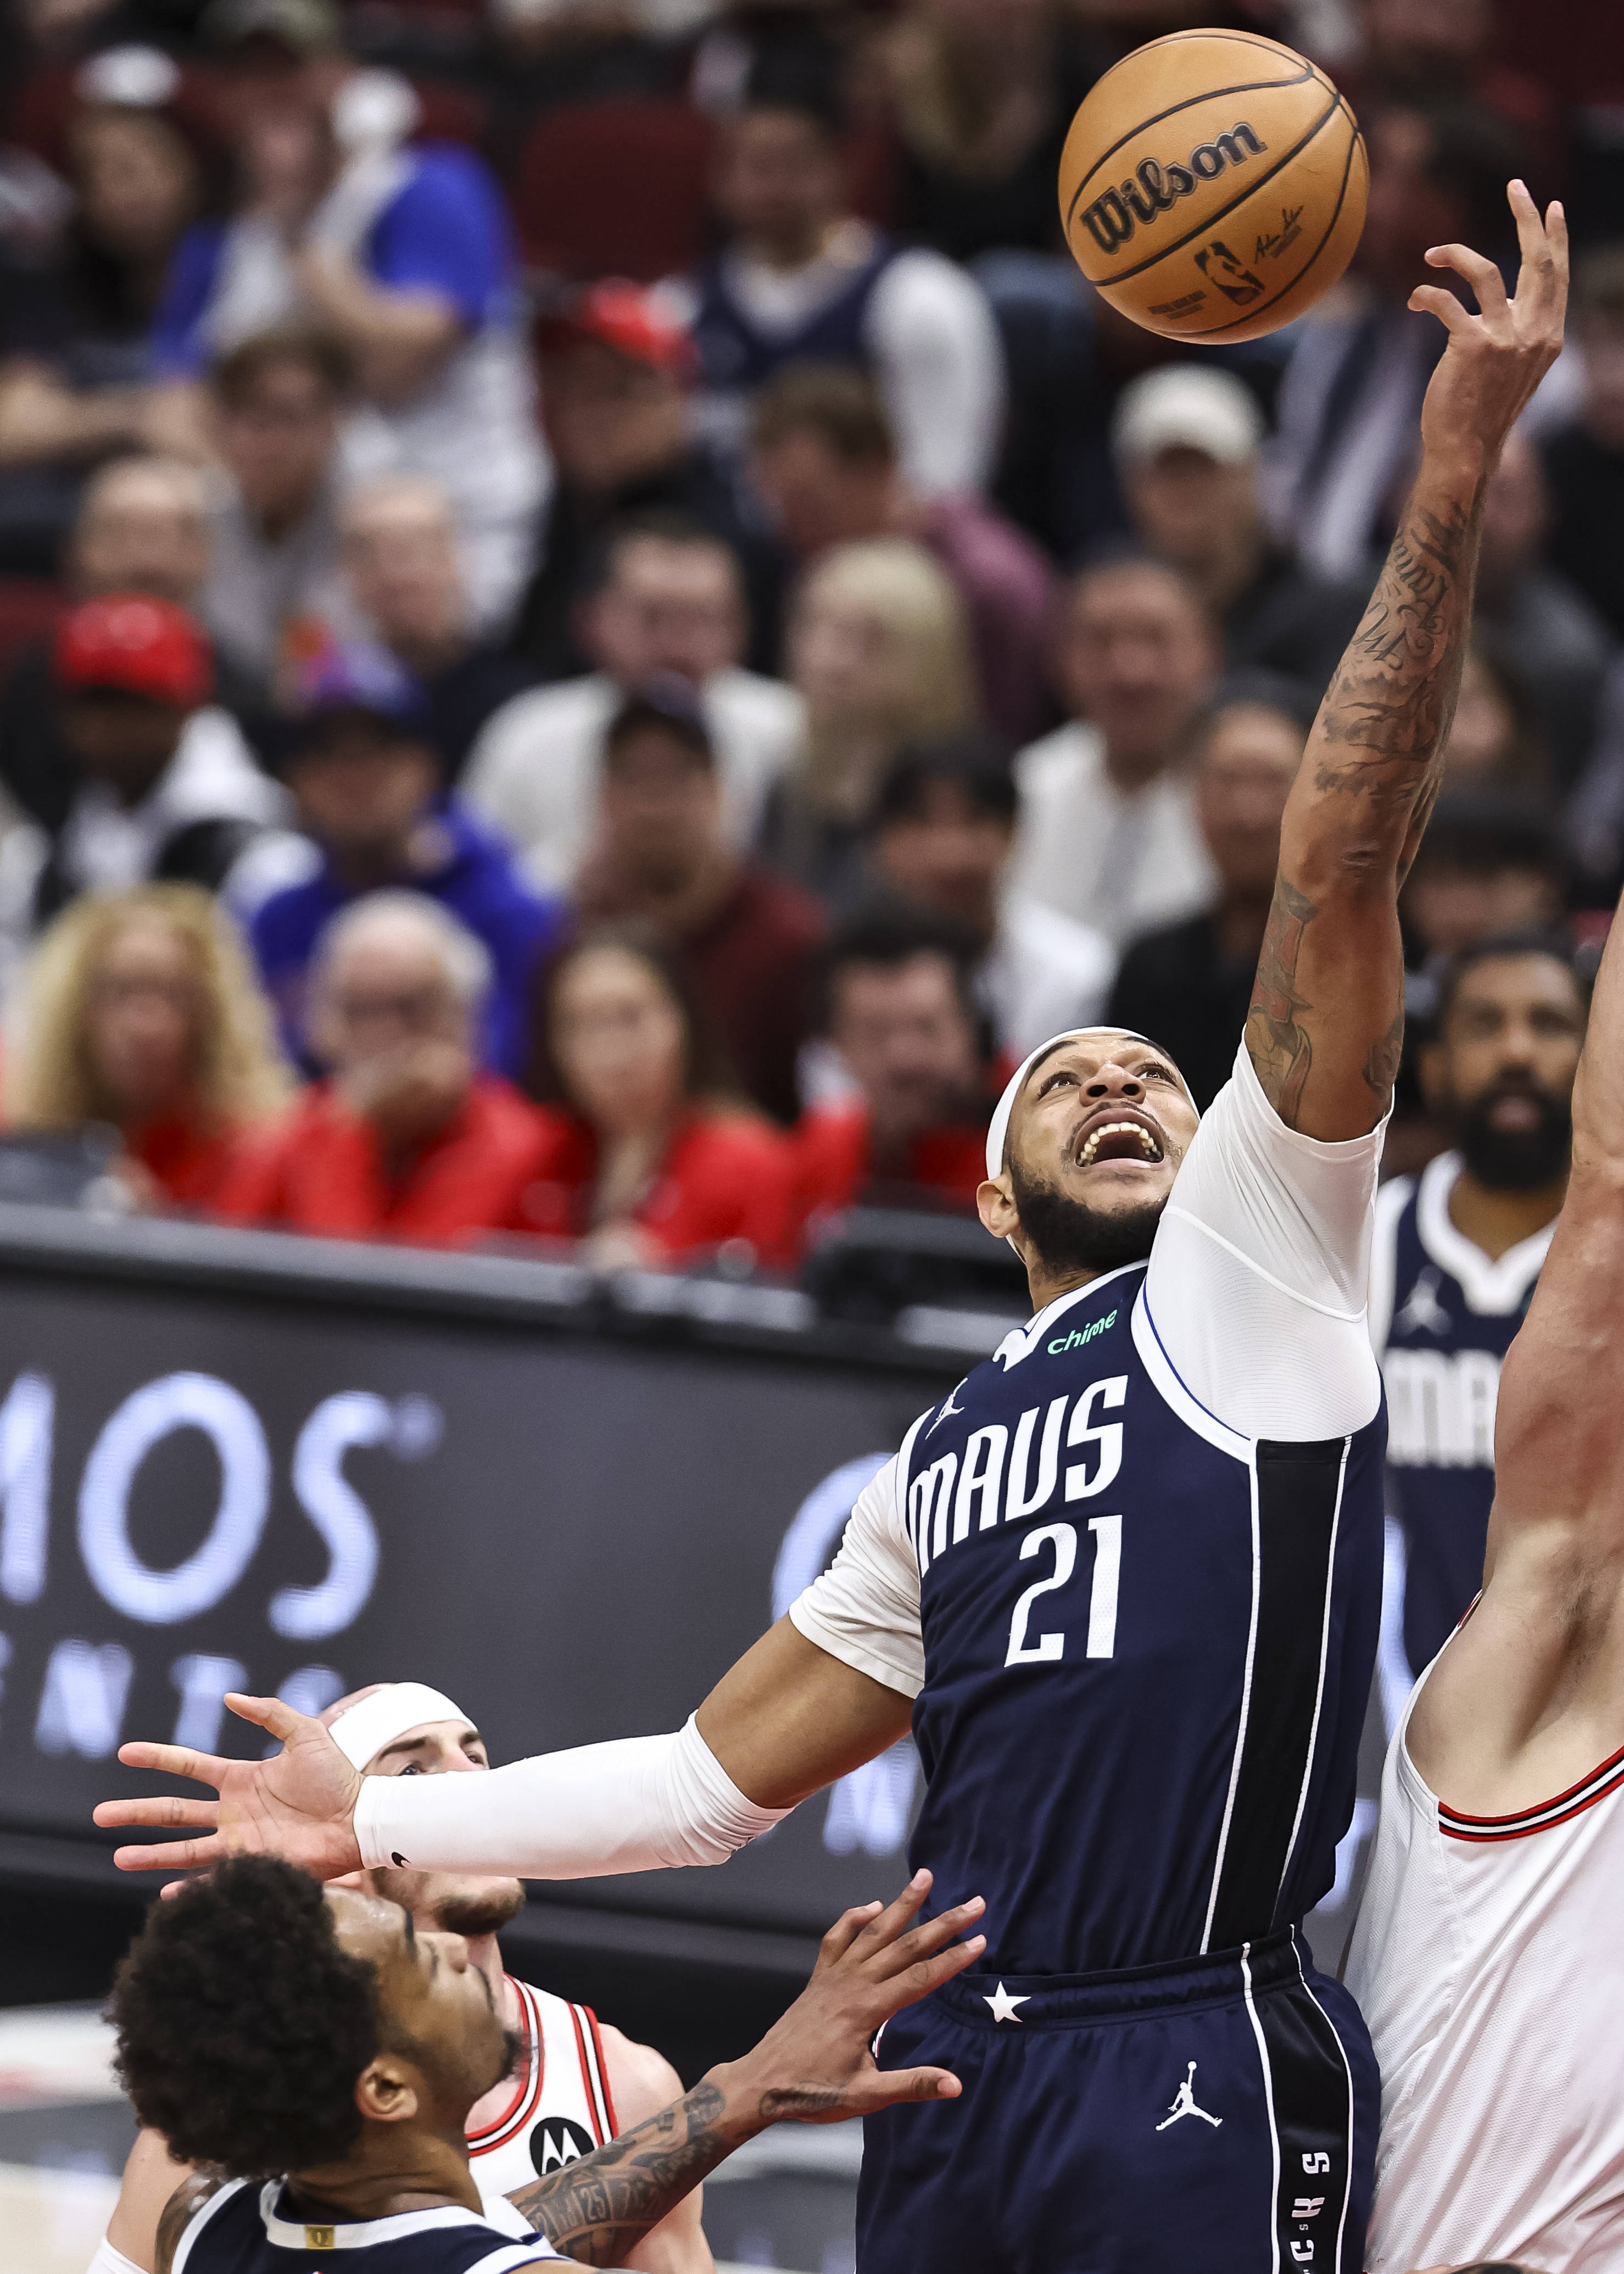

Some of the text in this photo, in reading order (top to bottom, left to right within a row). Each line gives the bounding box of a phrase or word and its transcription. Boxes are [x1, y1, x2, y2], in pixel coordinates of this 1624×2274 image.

[1080, 122, 1268, 254] Wilson
[1047, 1309, 1118, 1355] chime
[1004, 1514, 1123, 1668] 21
